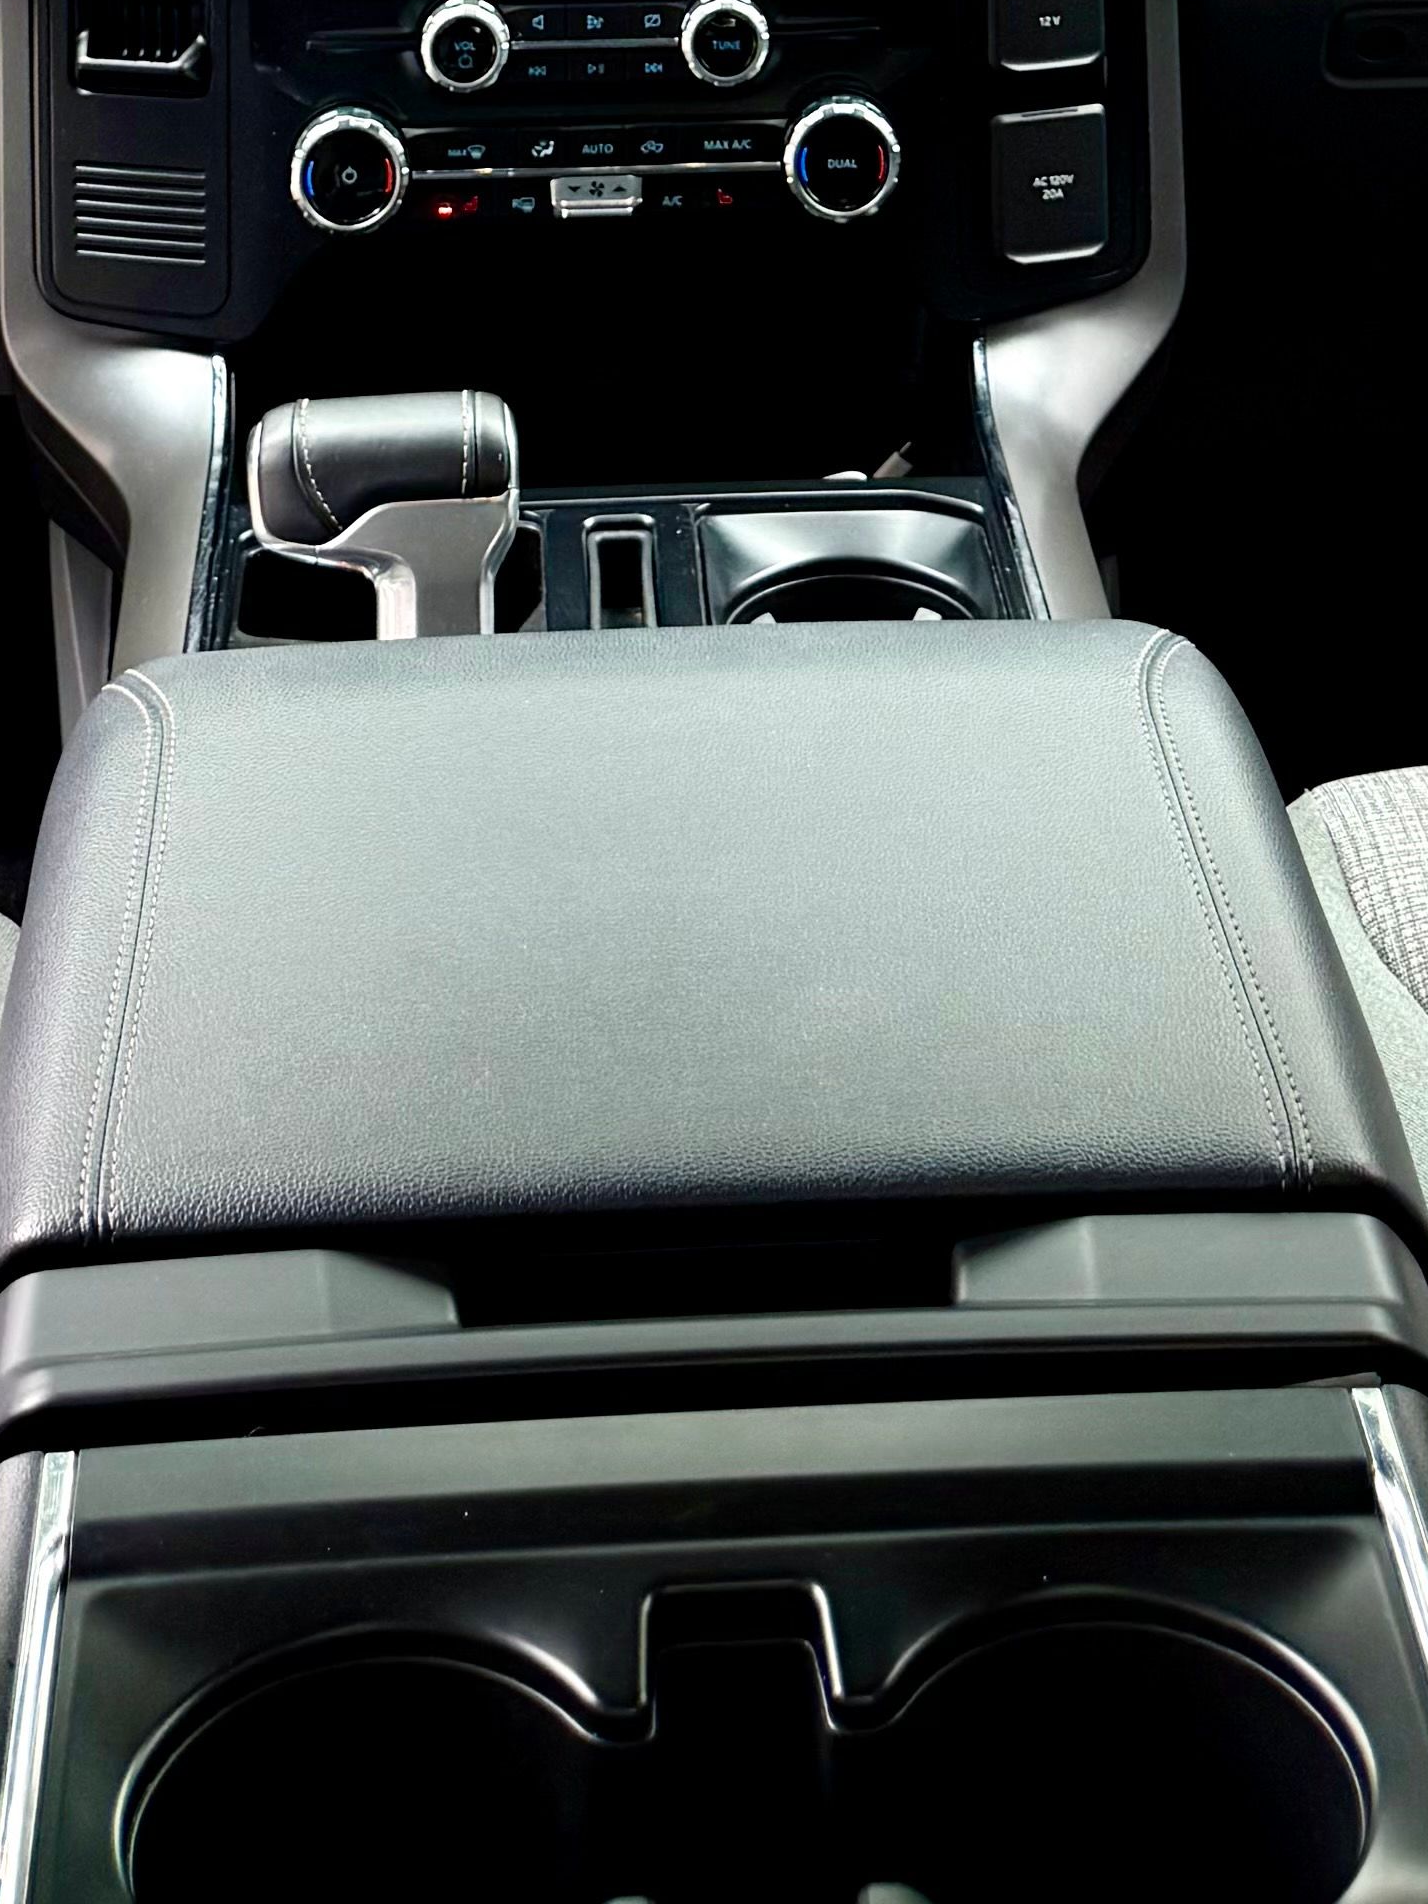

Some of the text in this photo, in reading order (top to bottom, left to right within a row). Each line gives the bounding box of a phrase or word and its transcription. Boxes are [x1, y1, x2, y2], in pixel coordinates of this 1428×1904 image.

[453, 41, 476, 52] VOL
[712, 40, 741, 51] TUNE
[581, 143, 614, 155] AUTO
[703, 138, 753, 151] MAX A/C
[827, 158, 858, 170] DUAL
[661, 194, 684, 207] A/C
